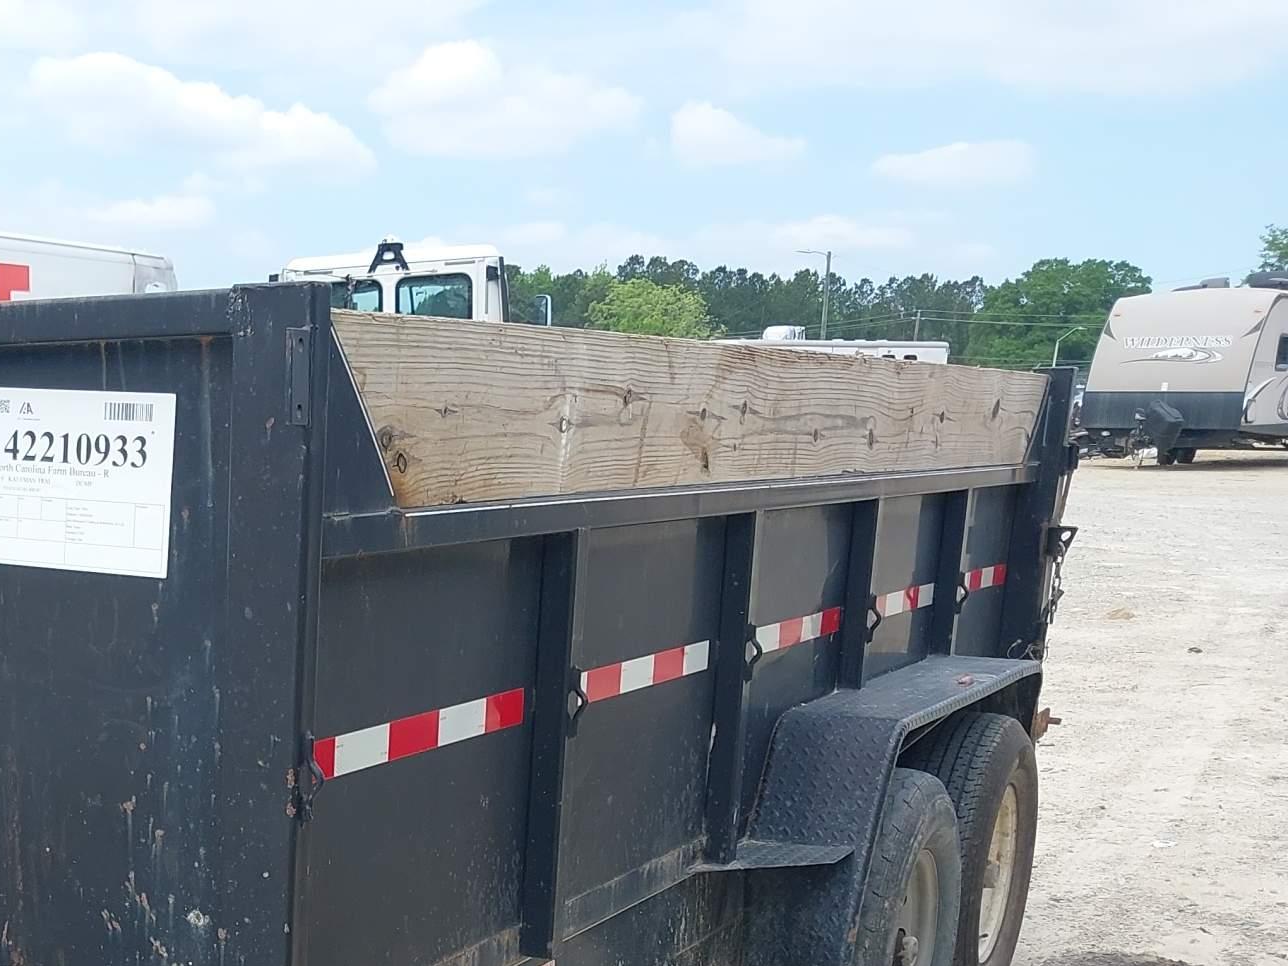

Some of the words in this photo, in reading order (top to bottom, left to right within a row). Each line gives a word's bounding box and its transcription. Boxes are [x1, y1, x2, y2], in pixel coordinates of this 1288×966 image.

[1123, 335, 1233, 349] WILDERNESS
[4, 429, 148, 468] 42210933
[15, 464, 46, 475] Carolina
[48, 466, 67, 476] Farm
[69, 467, 96, 478] Bureau
[103, 469, 110, 478] R
